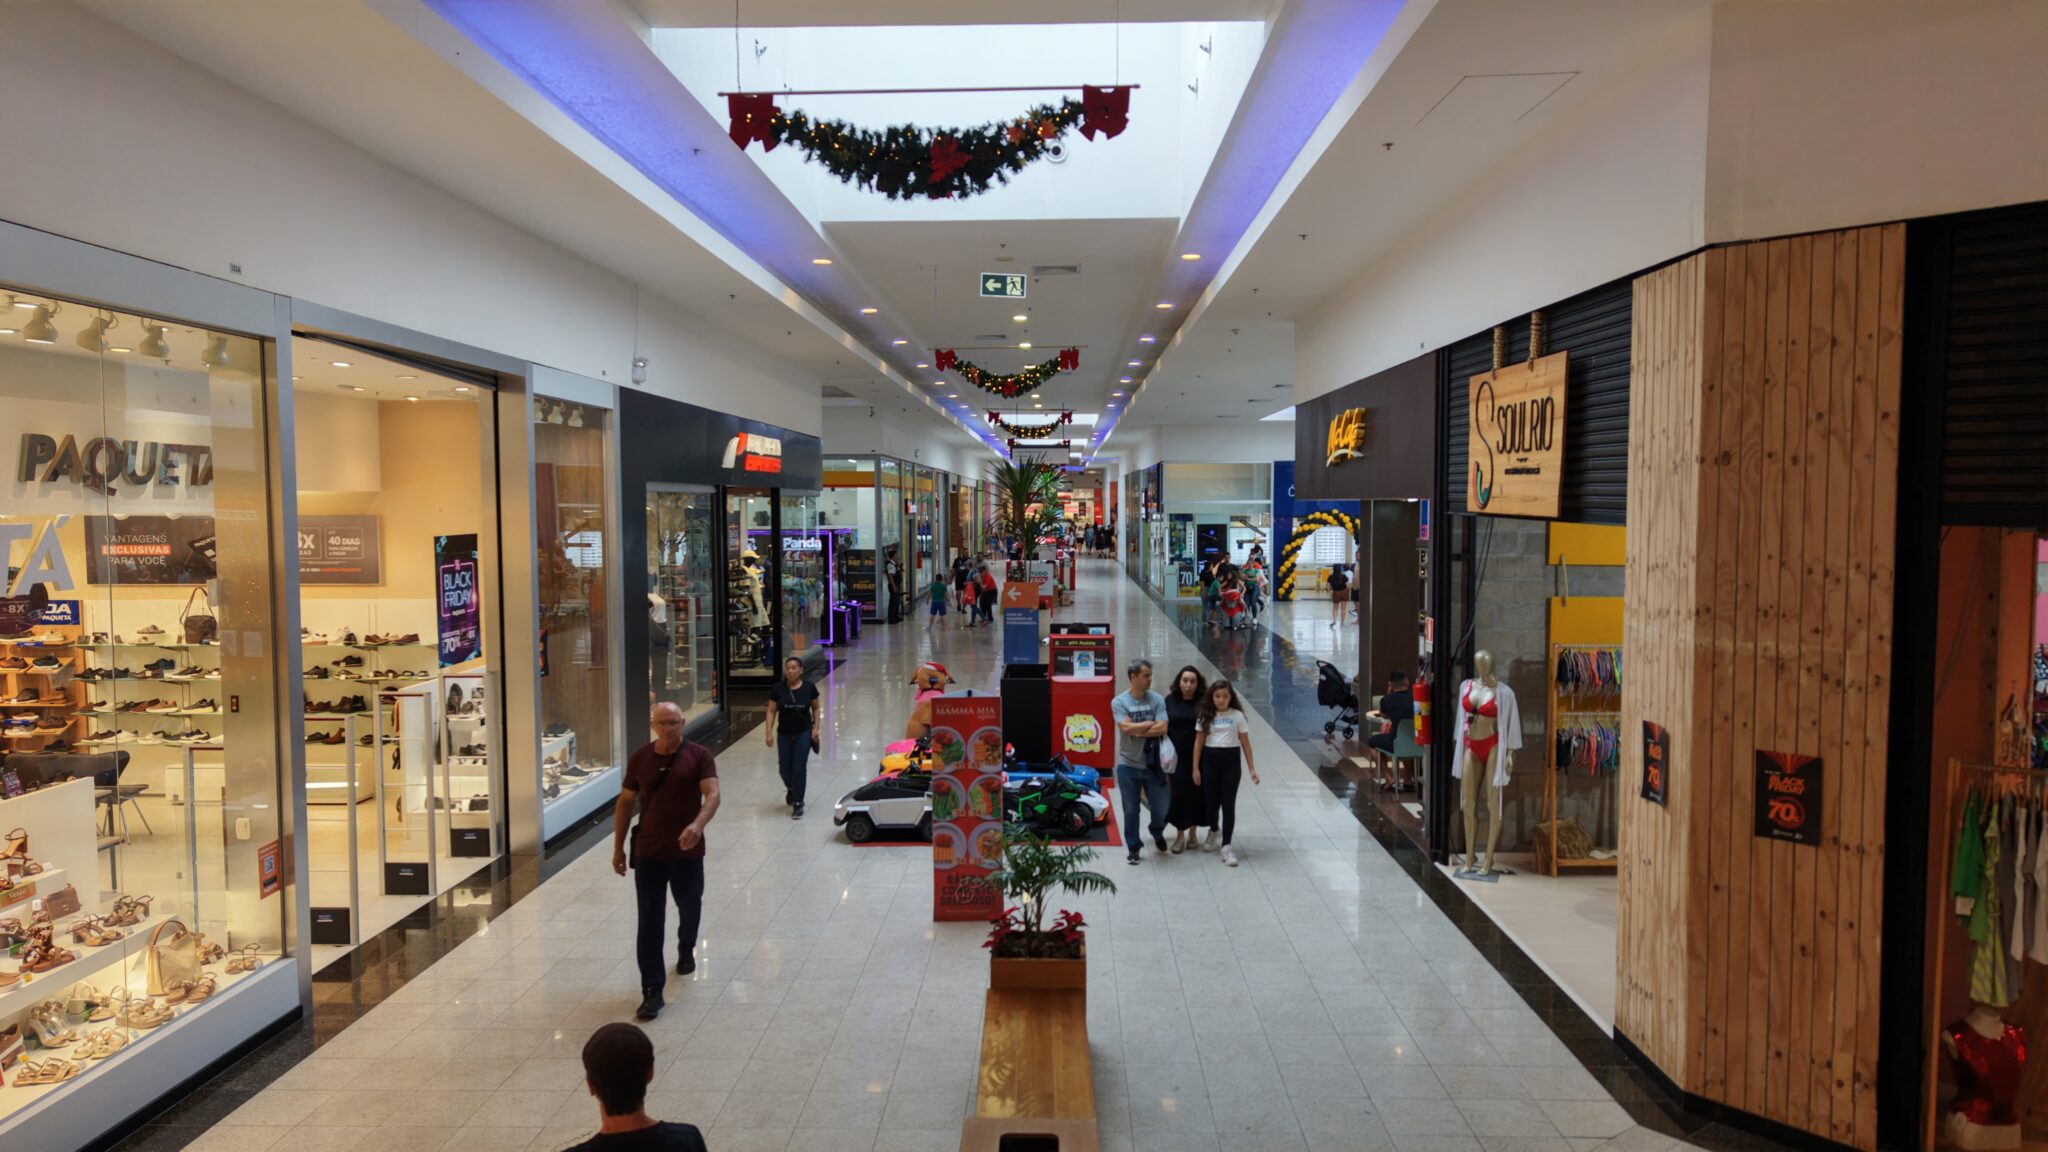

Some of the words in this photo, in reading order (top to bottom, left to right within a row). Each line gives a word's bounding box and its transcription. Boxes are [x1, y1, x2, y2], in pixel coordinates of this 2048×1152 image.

[1496, 396, 1555, 455] SOULRIO
[104, 534, 168, 543] VANTAGENS
[328, 536, 340, 545] 40
[342, 537, 360, 546] DIAS
[783, 537, 822, 551] Panda
[103, 545, 170, 555] EXCLUSIVAS
[138, 555, 166, 565] VOCÊ
[444, 570, 472, 591] BLACK
[1180, 571, 1192, 586] 70
[444, 588, 472, 609] FRIDAY
[935, 706, 975, 716] MAMMA
[977, 705, 996, 715] MIA
